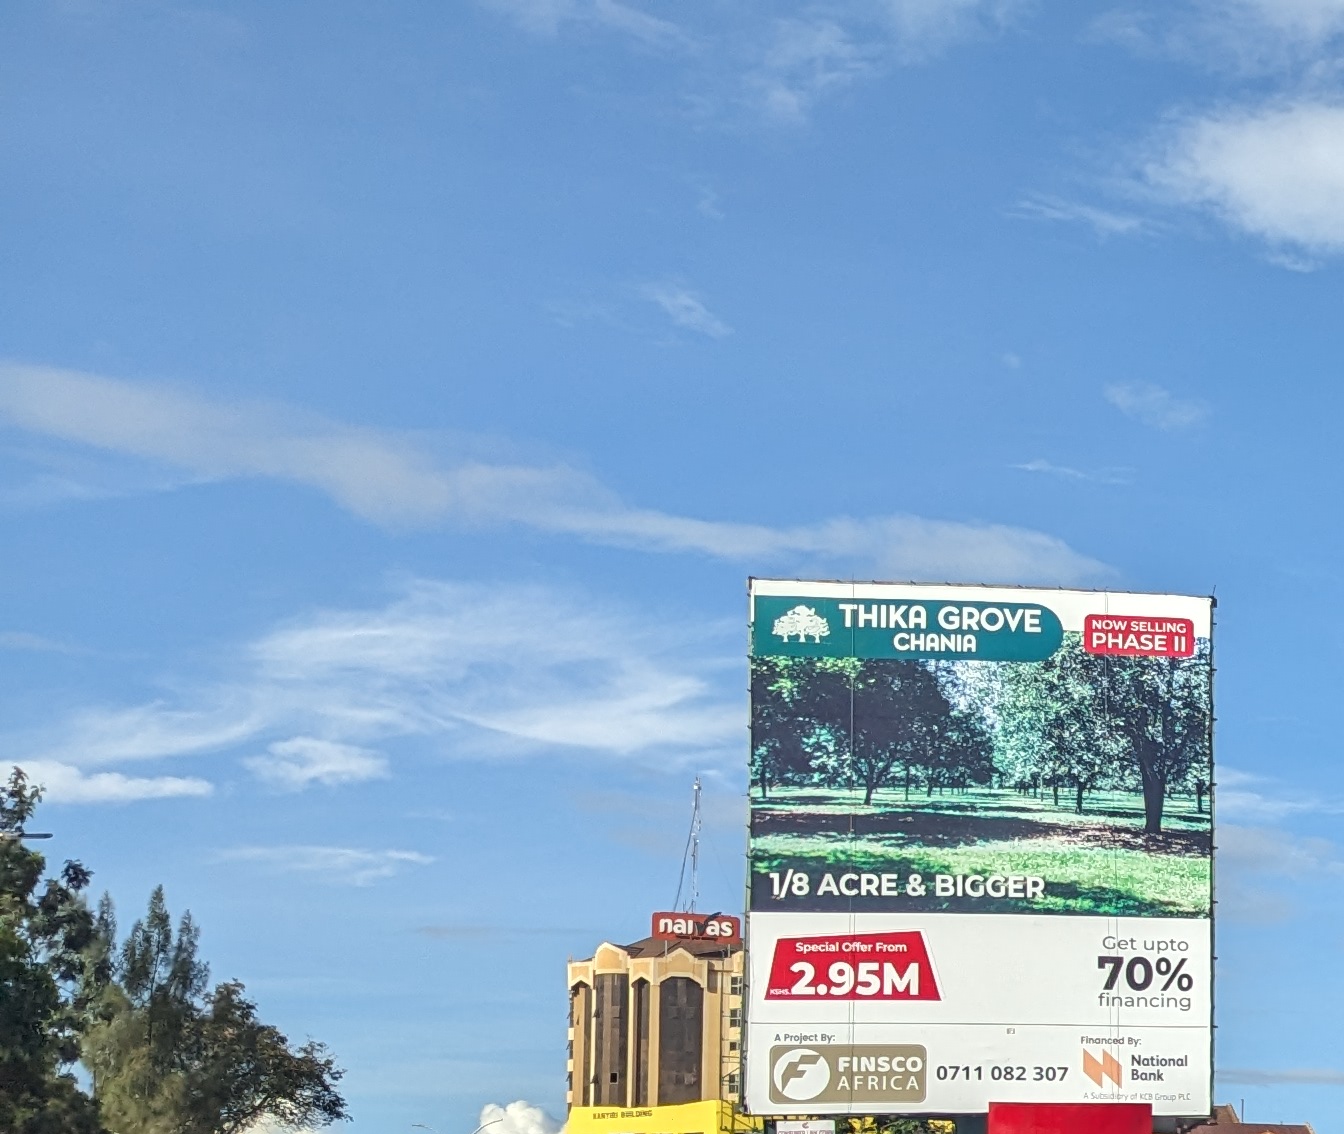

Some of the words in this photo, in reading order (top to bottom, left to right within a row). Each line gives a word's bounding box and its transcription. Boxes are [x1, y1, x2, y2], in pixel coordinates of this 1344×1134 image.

[839, 603, 926, 629] THIKA
[937, 605, 1042, 633] GROVE
[1092, 619, 1127, 631] NOW
[1130, 621, 1187, 634] SELLING
[893, 633, 977, 653] CHANIA
[1092, 632, 1168, 651] PHASE
[1174, 635, 1186, 652] II
[769, 868, 810, 898] 1/8
[816, 873, 898, 897] ACRE
[905, 873, 927, 897] &
[935, 874, 1046, 898] BIGGER
[795, 942, 839, 954] Special
[842, 942, 873, 953] Offer
[876, 942, 908, 953] From
[1102, 936, 1138, 951] Get
[1143, 938, 1189, 955] upto
[790, 961, 920, 996] 2.95M
[1097, 955, 1194, 992] 70%
[1097, 992, 1191, 1011] financing
[774, 1033, 781, 1042] A
[783, 1033, 818, 1044] Project
[820, 1033, 836, 1044] By:
[1080, 1036, 1125, 1045] Financed
[1127, 1037, 1142, 1047] By:
[838, 1056, 923, 1073] FINSCO
[1131, 1054, 1188, 1067] National
[936, 1065, 983, 1081] 0711
[990, 1065, 1027, 1081] 082
[1032, 1066, 1069, 1081] 307
[1131, 1068, 1165, 1081] Bank
[837, 1075, 920, 1091] AFRICA
[1083, 1092, 1089, 1100] A
[1090, 1092, 1129, 1101] Subsidiary
[1130, 1092, 1138, 1100] of
[1154, 1093, 1177, 1102] Group
